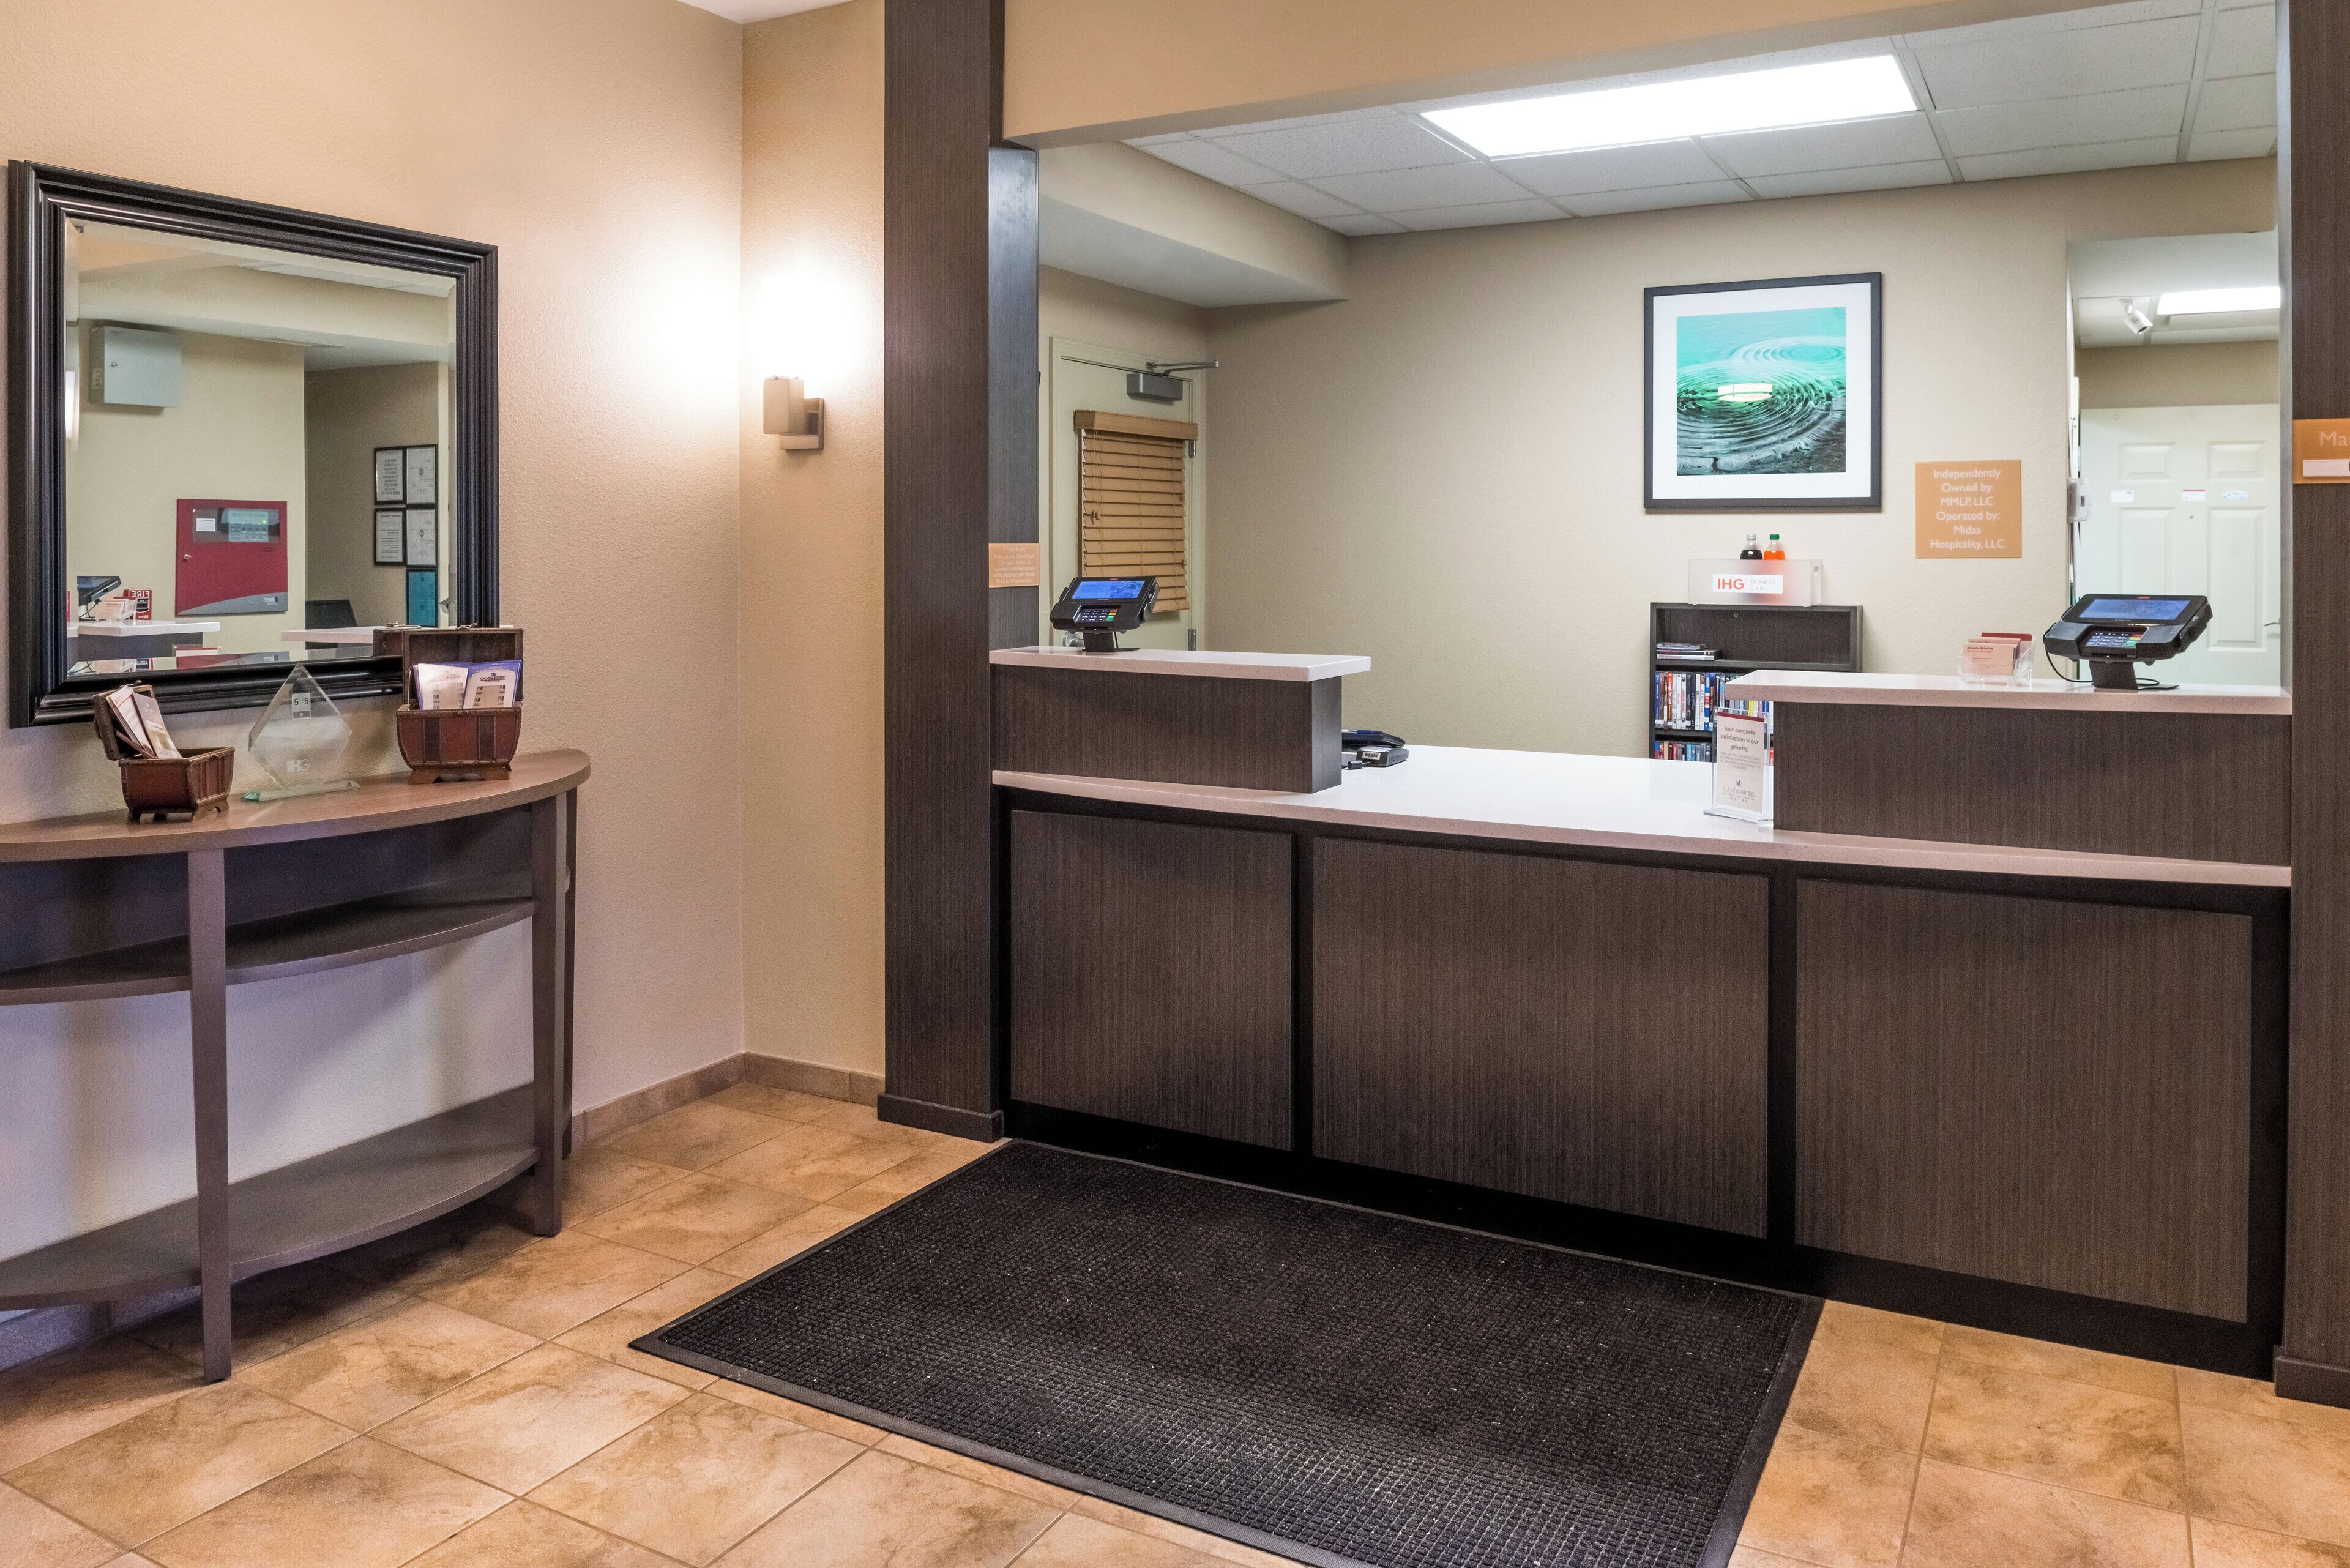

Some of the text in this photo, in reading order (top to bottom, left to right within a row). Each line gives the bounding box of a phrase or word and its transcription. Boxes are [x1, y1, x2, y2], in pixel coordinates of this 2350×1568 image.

[1934, 469, 2001, 479] Independently
[1941, 483, 1994, 494] Owned by:
[1941, 496, 1994, 507] MMLP, LLC
[1936, 511, 2000, 523] Operated by:
[1953, 525, 1981, 535] Midas
[1930, 539, 2005, 550] Hospitality, LLC
[1718, 578, 1745, 589] IHG
[1731, 744, 1749, 752] priority.
